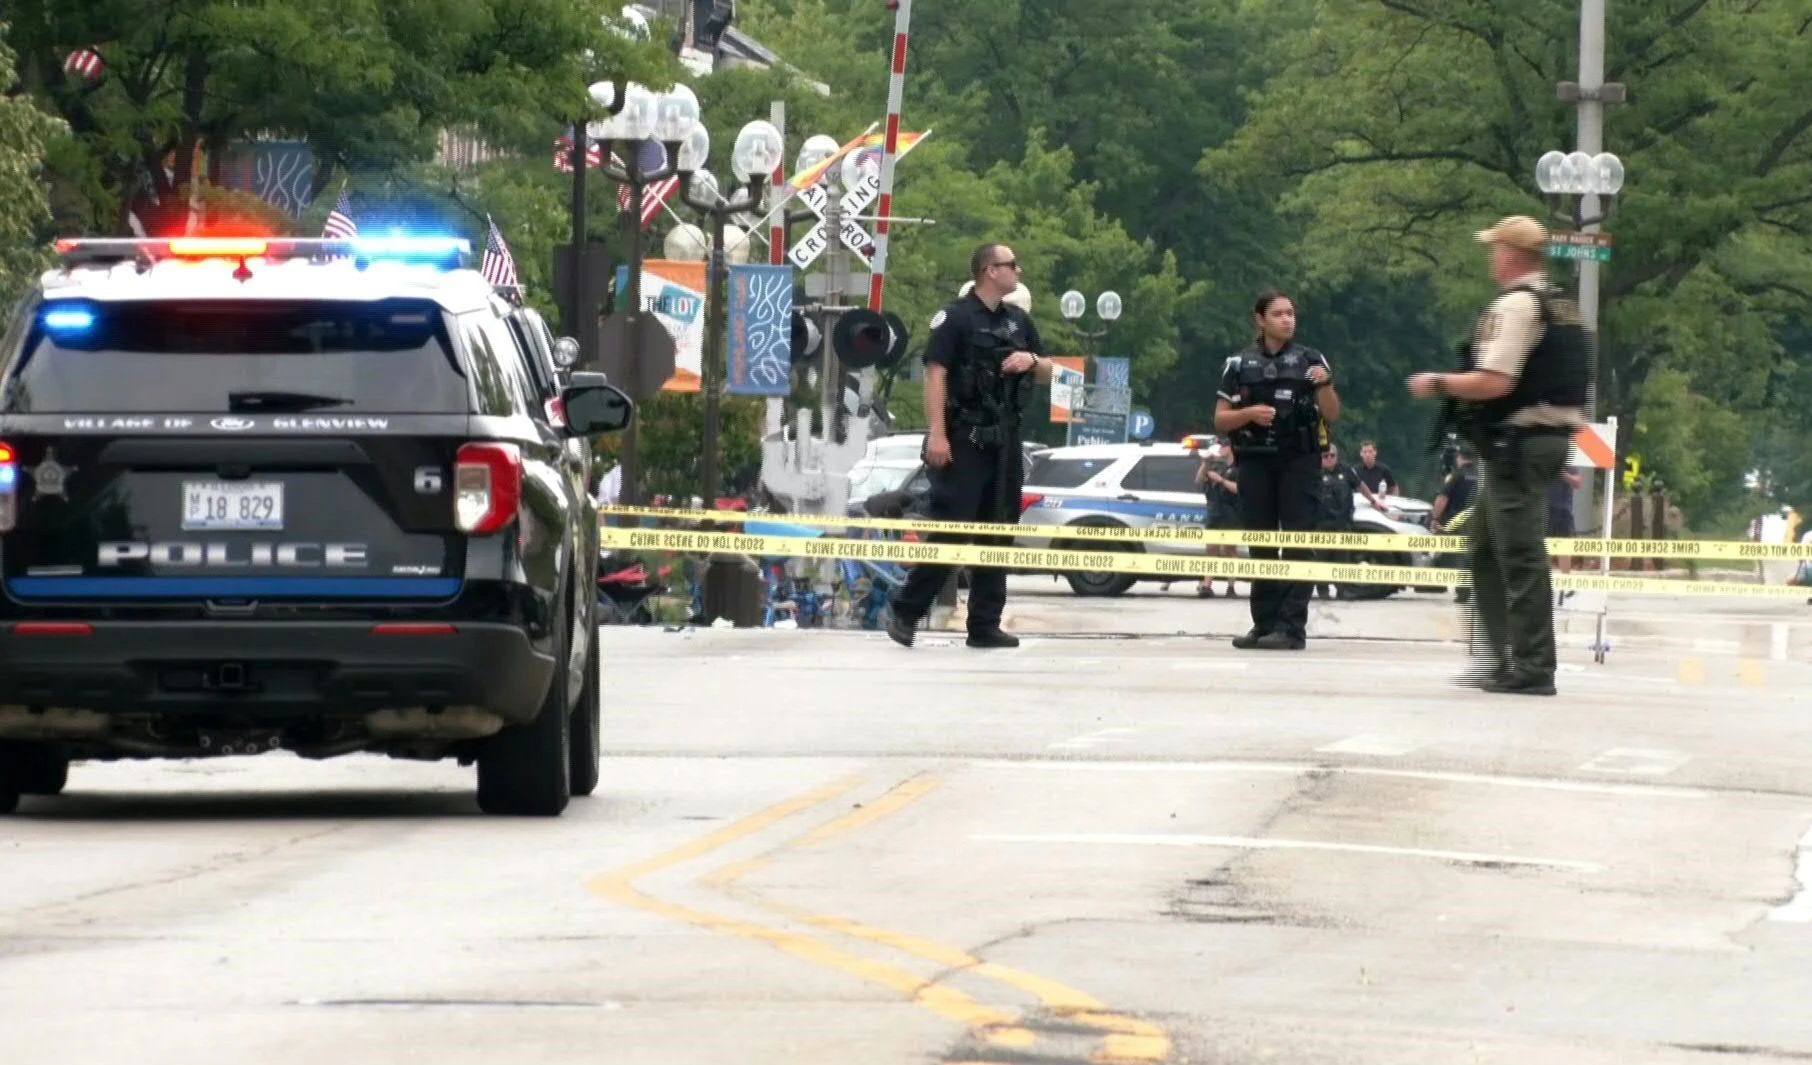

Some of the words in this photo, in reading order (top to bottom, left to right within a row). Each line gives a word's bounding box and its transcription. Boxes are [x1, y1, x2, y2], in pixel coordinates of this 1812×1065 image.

[795, 175, 880, 262] CROING
[1551, 246, 1562, 257] ST
[1566, 247, 1597, 259] JOHNS
[668, 297, 697, 317] LOT
[63, 418, 153, 430] VILLAGE
[163, 418, 193, 430] OF
[272, 418, 389, 430] GLENVIEW
[1136, 416, 1148, 434] P
[414, 467, 441, 494] 6
[206, 496, 228, 520] 18
[240, 496, 273, 520] 829
[99, 543, 369, 566] POLICE
